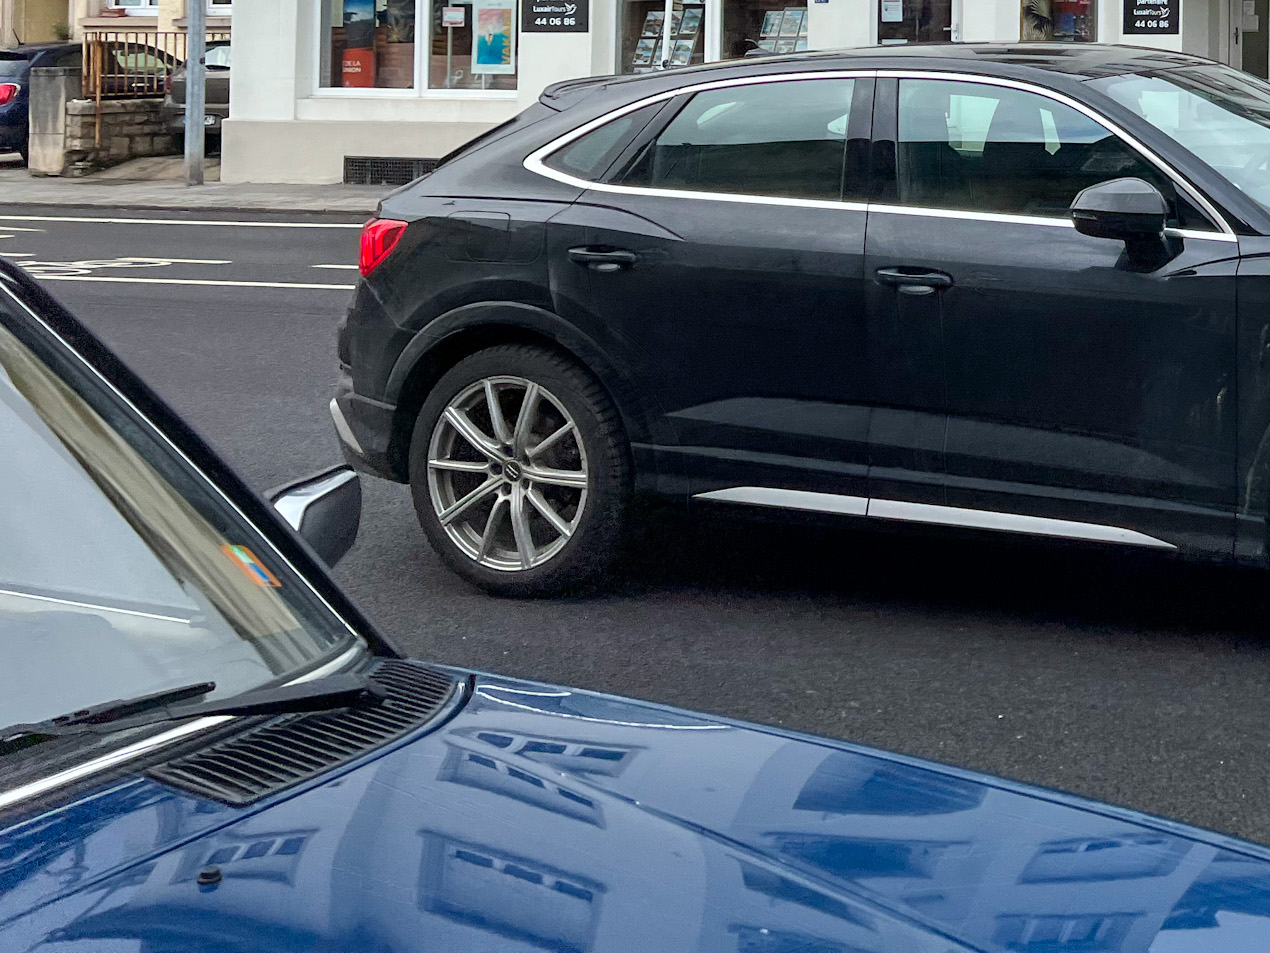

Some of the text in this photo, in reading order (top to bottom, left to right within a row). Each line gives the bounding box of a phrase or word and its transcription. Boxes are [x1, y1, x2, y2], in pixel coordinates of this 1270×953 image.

[534, 17, 576, 26] 44 06 86
[1134, 20, 1169, 28] 44 06 86
